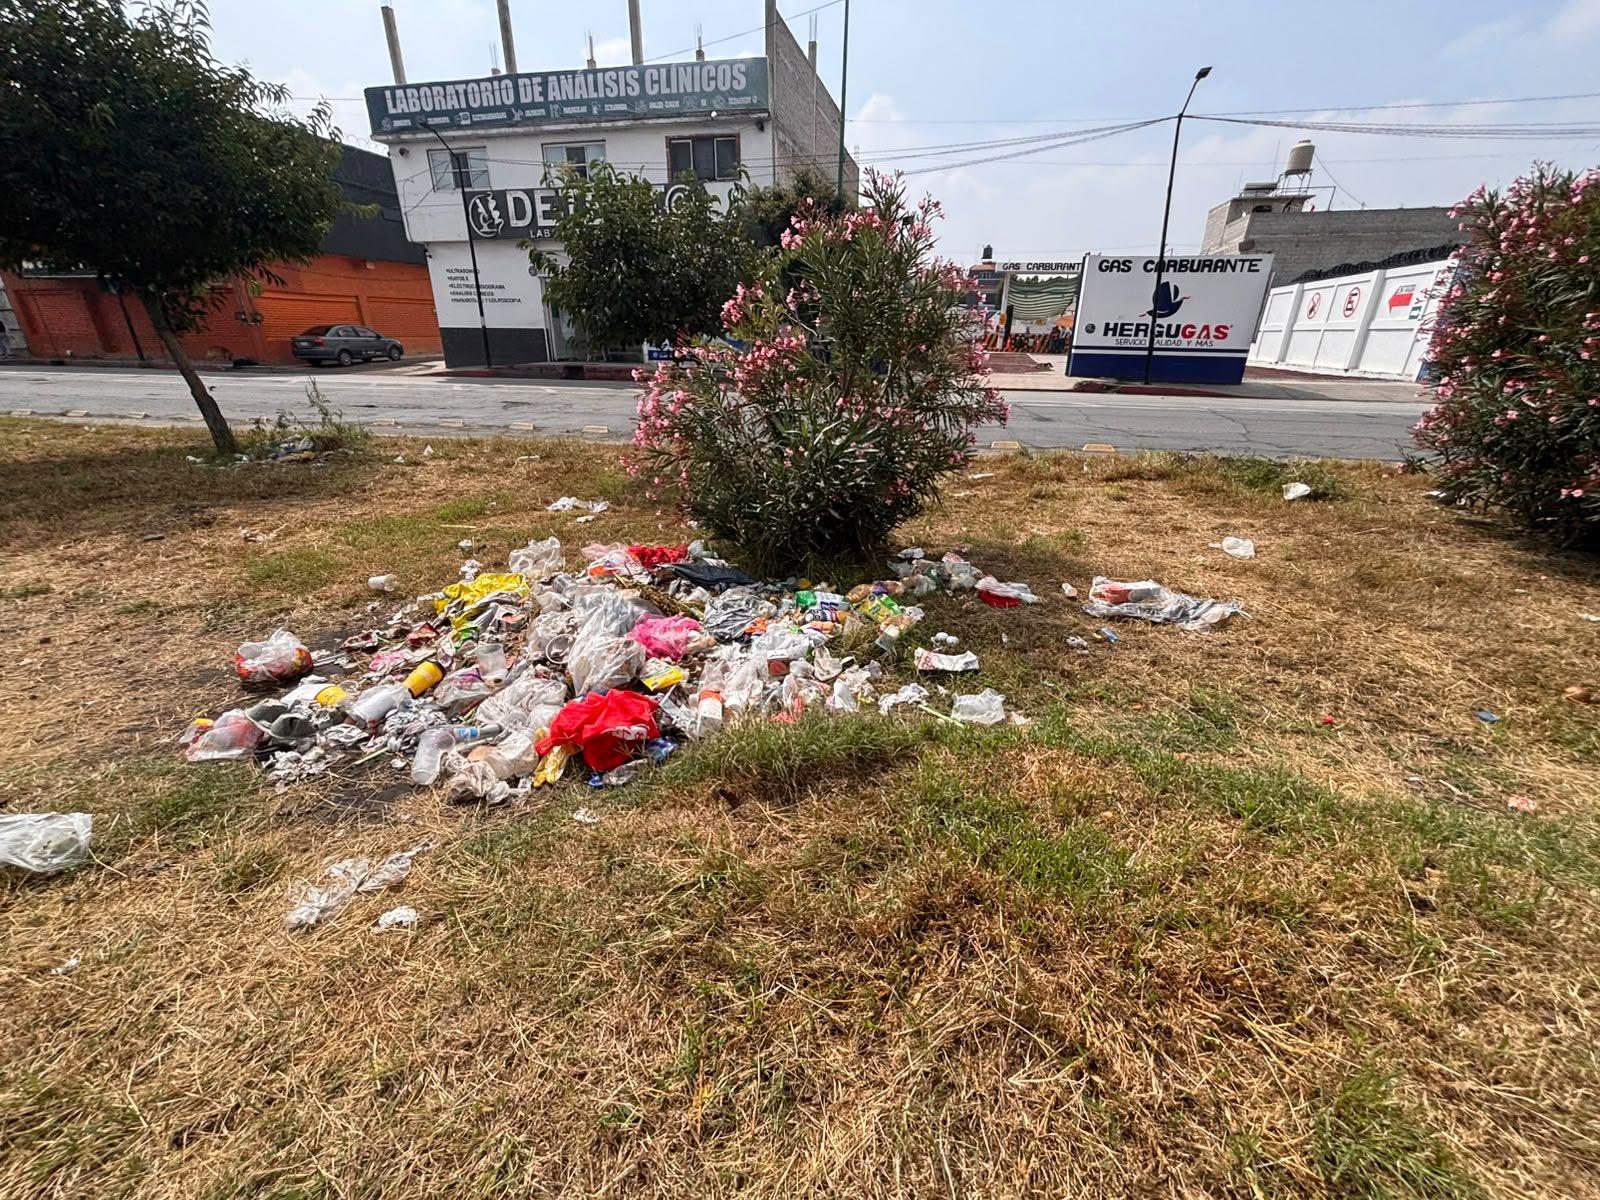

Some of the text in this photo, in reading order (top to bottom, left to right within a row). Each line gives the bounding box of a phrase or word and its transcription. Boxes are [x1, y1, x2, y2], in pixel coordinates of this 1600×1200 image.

[384, 63, 747, 114] LABORATORIO DE ANÁLISIS CLÍNICOS
[1002, 262, 1083, 271] GAS CARBURANT
[1098, 259, 1263, 273] GAS CARBURANTE
[1103, 322, 1229, 340] HERGUGAS
[1115, 338, 1147, 346] SERVICIO
[1152, 339, 1183, 347] ALIDAD
